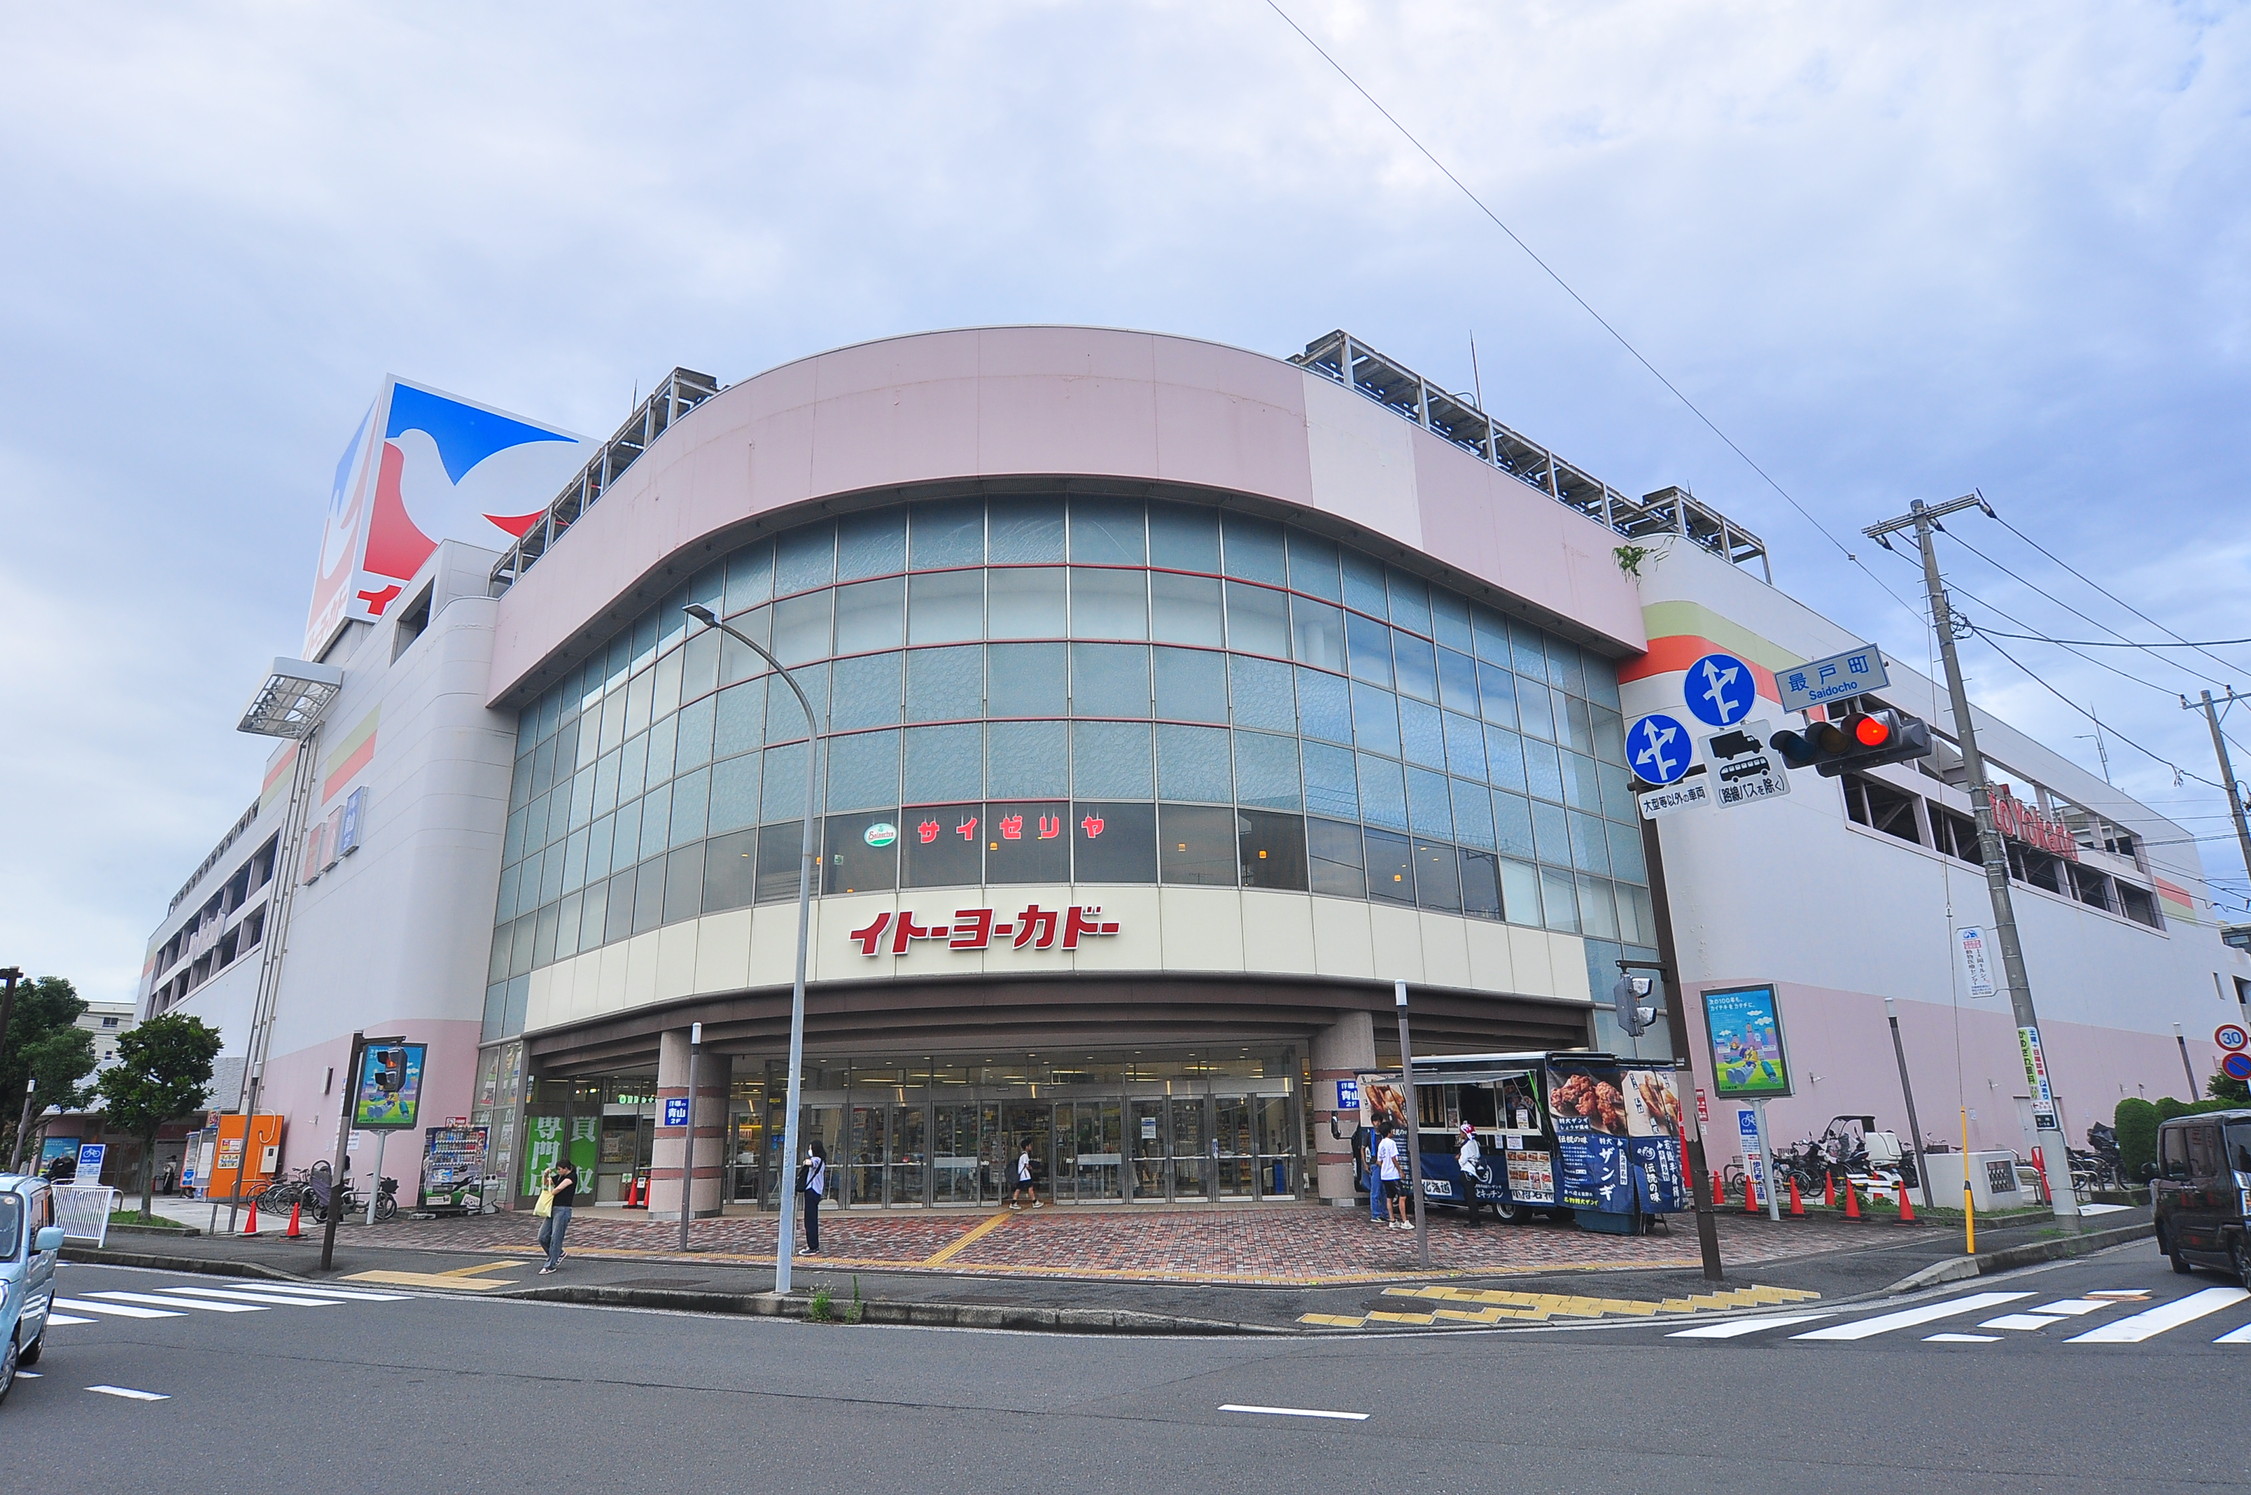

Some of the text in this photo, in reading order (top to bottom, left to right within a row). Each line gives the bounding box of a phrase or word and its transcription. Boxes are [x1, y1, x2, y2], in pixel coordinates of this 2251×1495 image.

[1788, 655, 1869, 692] 最戸町
[1808, 681, 1858, 700] Saidocho
[1643, 786, 1706, 813] 大型等以外の車両
[1718, 775, 1785, 804] (路線バスを除く)
[917, 815, 1105, 844] サイゼリヤ
[849, 903, 1121, 957] イトーヨーカドー
[2221, 1031, 2242, 1045] 30
[1341, 1090, 1360, 1101] 青山
[667, 1107, 686, 1118] 青山
[1599, 1147, 1617, 1201] ザンギ
